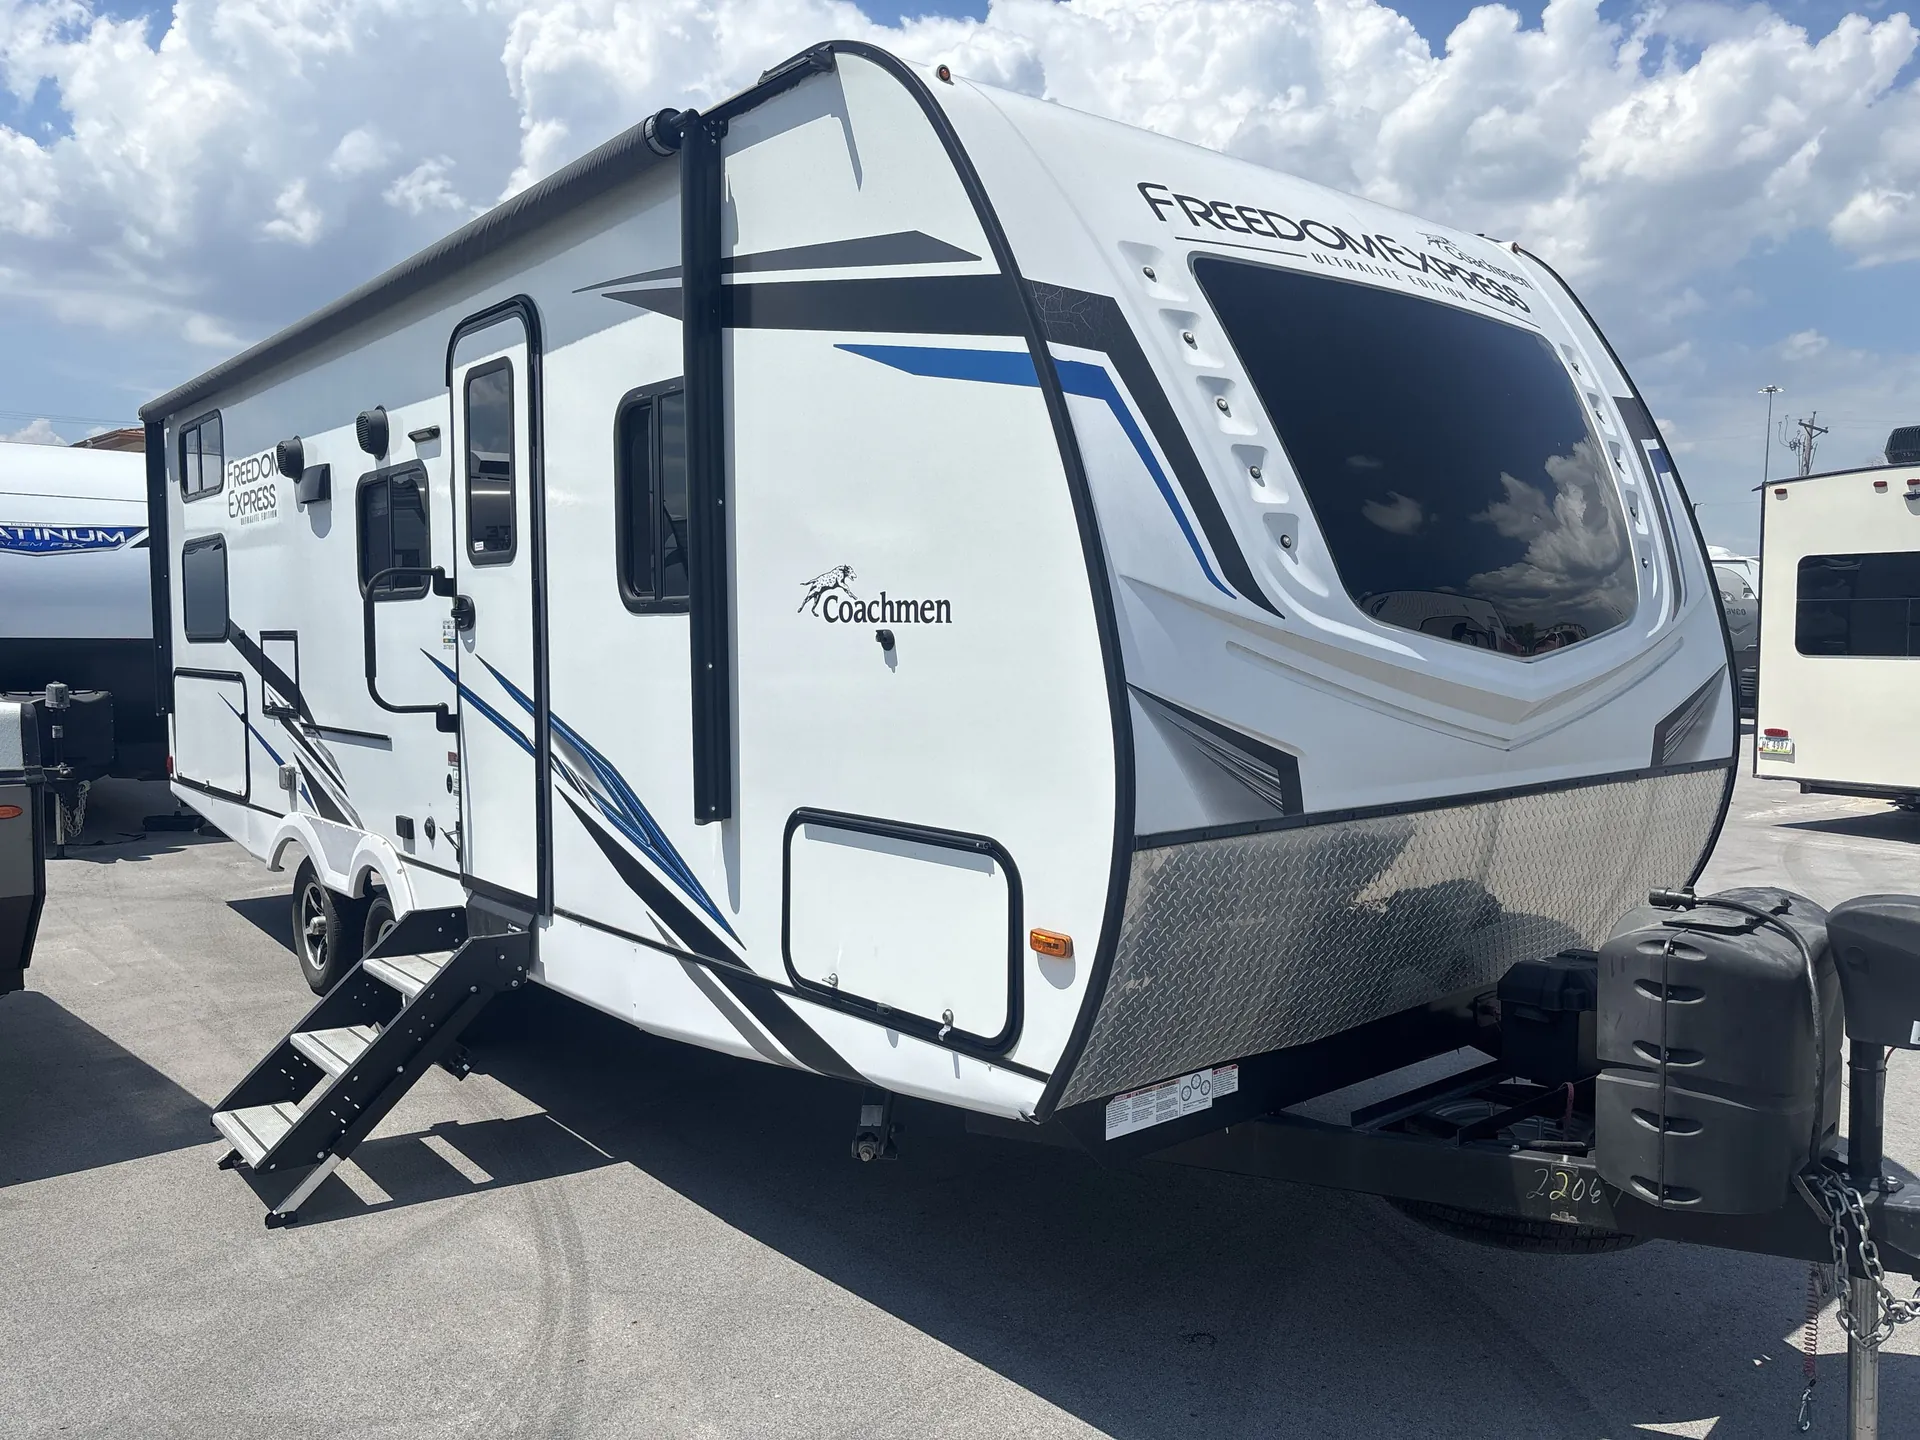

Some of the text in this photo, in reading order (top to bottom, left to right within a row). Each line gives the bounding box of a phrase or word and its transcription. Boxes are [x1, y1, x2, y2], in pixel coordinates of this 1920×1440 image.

[1311, 252, 1468, 302] ULTRALITE EDITION
[1444, 245, 1534, 291] Coachmen
[228, 483, 276, 519] EXPRESS
[822, 591, 953, 624] Coachmen
